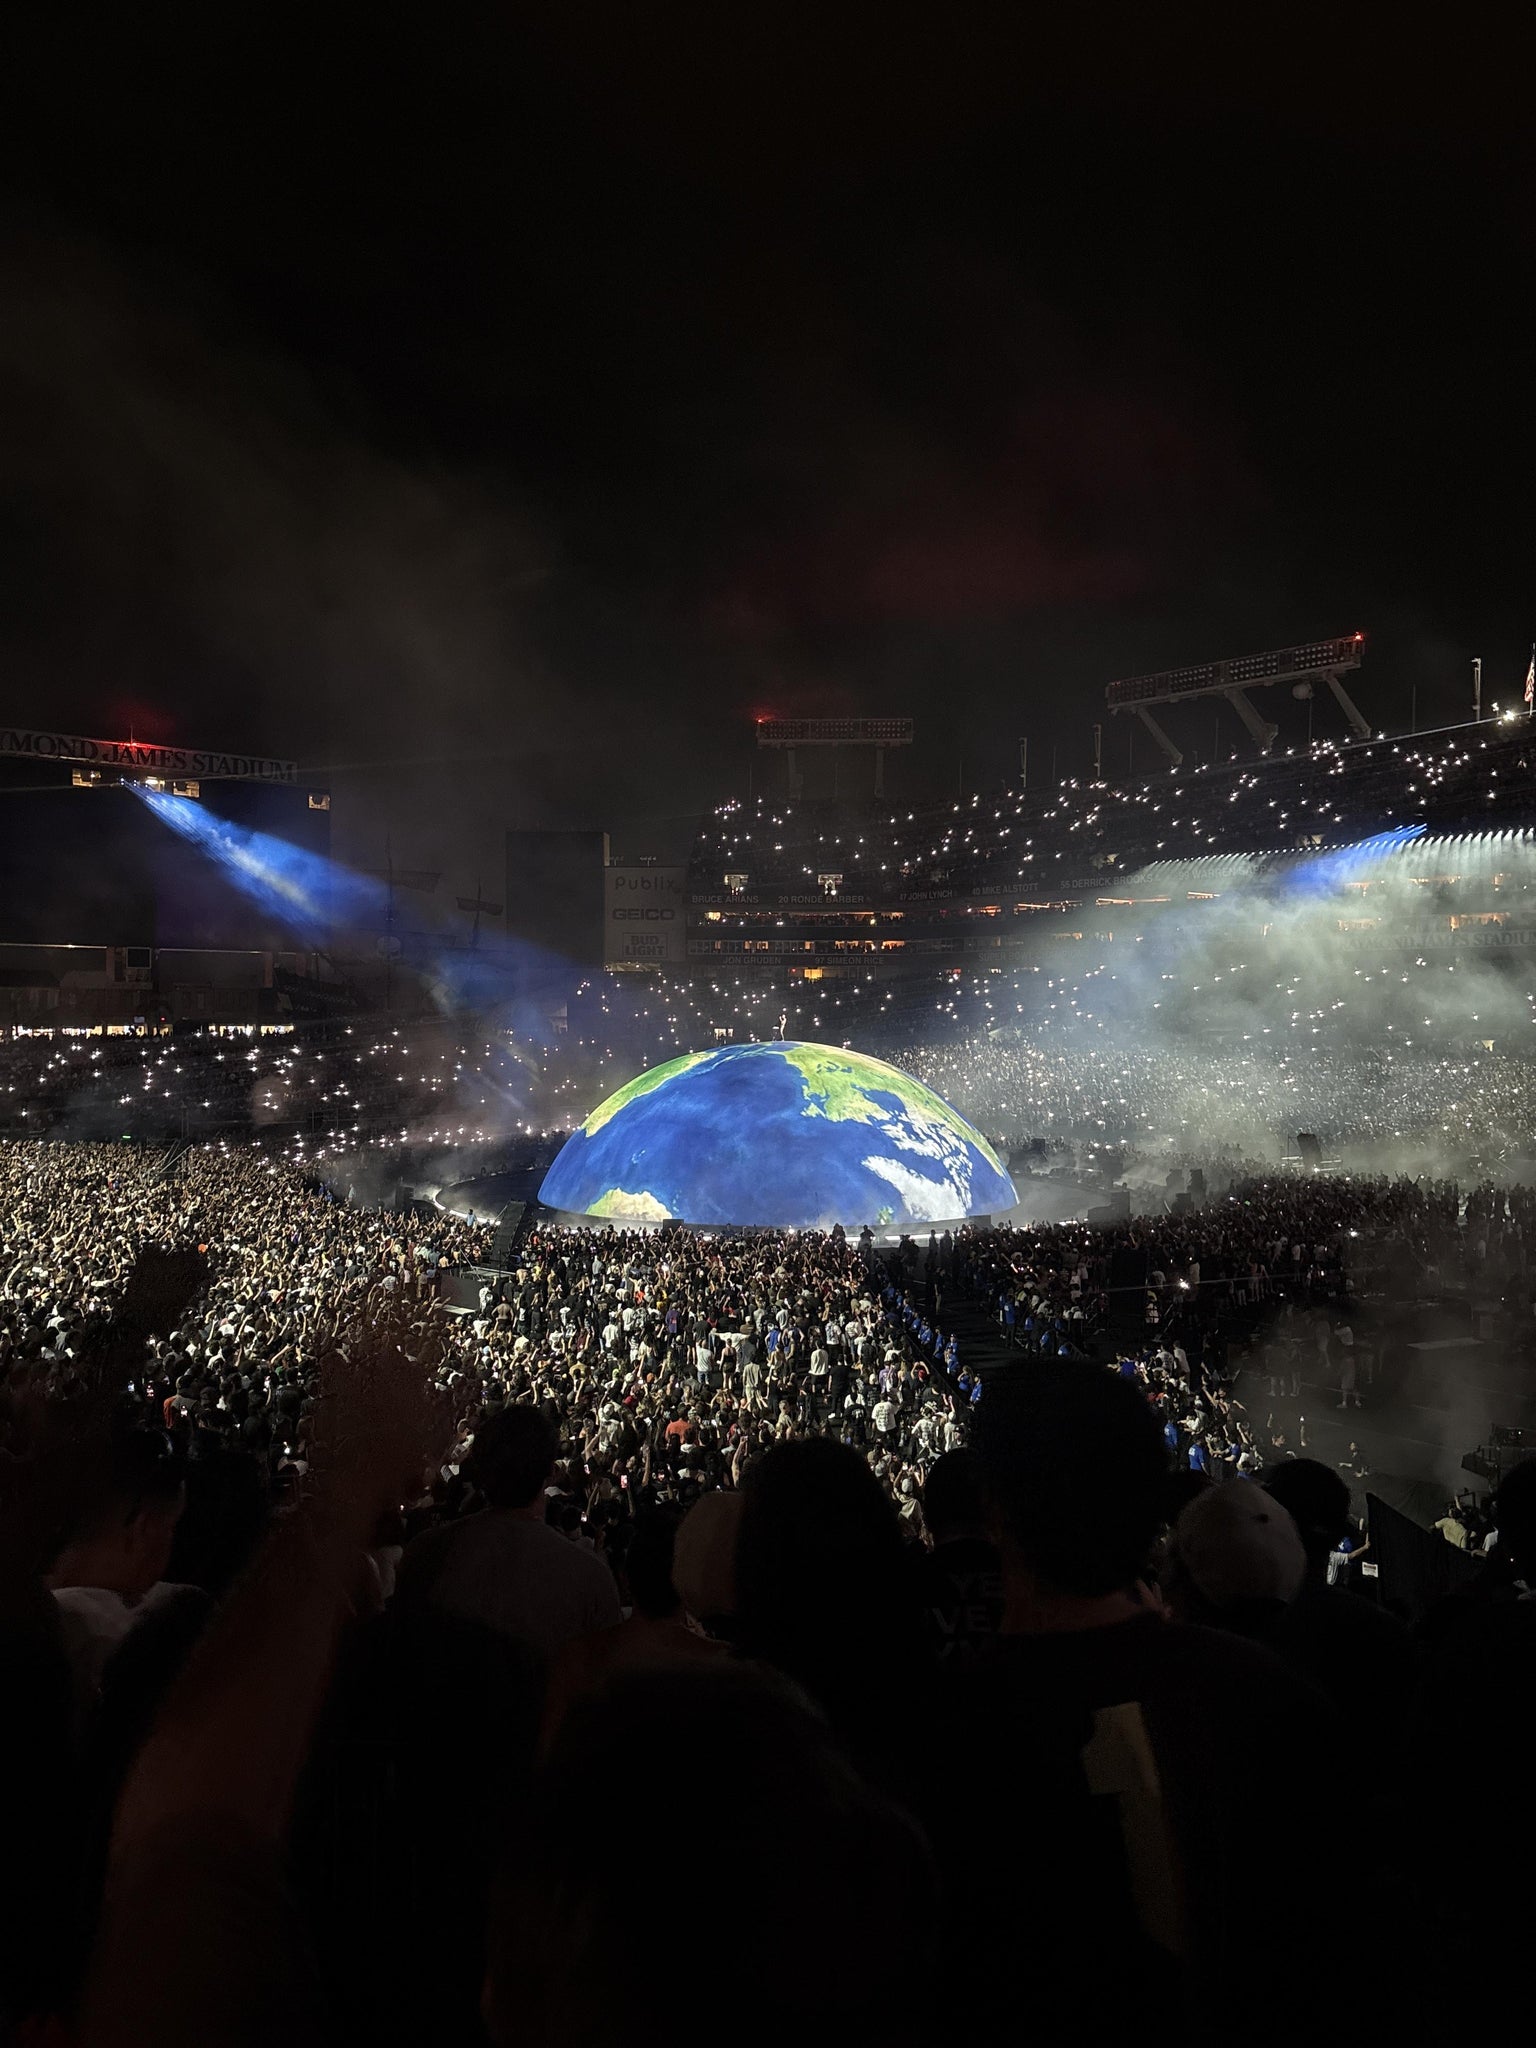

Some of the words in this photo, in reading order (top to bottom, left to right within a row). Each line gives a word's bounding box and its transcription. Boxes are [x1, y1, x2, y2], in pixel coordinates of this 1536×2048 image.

[102, 744, 186, 770] JAMES
[192, 754, 294, 780] STADIUM
[616, 876, 675, 891] Publix
[1060, 880, 1071, 889] 55
[1072, 878, 1111, 888] DERRICK
[1114, 874, 1153, 885] BROOKS
[908, 891, 928, 901] JOHN
[929, 889, 953, 899] LYNCH
[982, 886, 1001, 895] MIKE
[1002, 883, 1039, 893] ALSTOTT
[692, 895, 722, 904] BRUCE
[725, 895, 759, 904] ARIANS
[778, 895, 788, 904] 20
[792, 895, 823, 904] RONDE
[825, 895, 864, 904] BARBER
[612, 908, 675, 921] GEICO
[630, 935, 658, 945] BUD
[1474, 931, 1536, 946] STADIU
[624, 946, 665, 955] LIGHT
[827, 957, 860, 965] SIMEON
[864, 957, 885, 965] RICE
